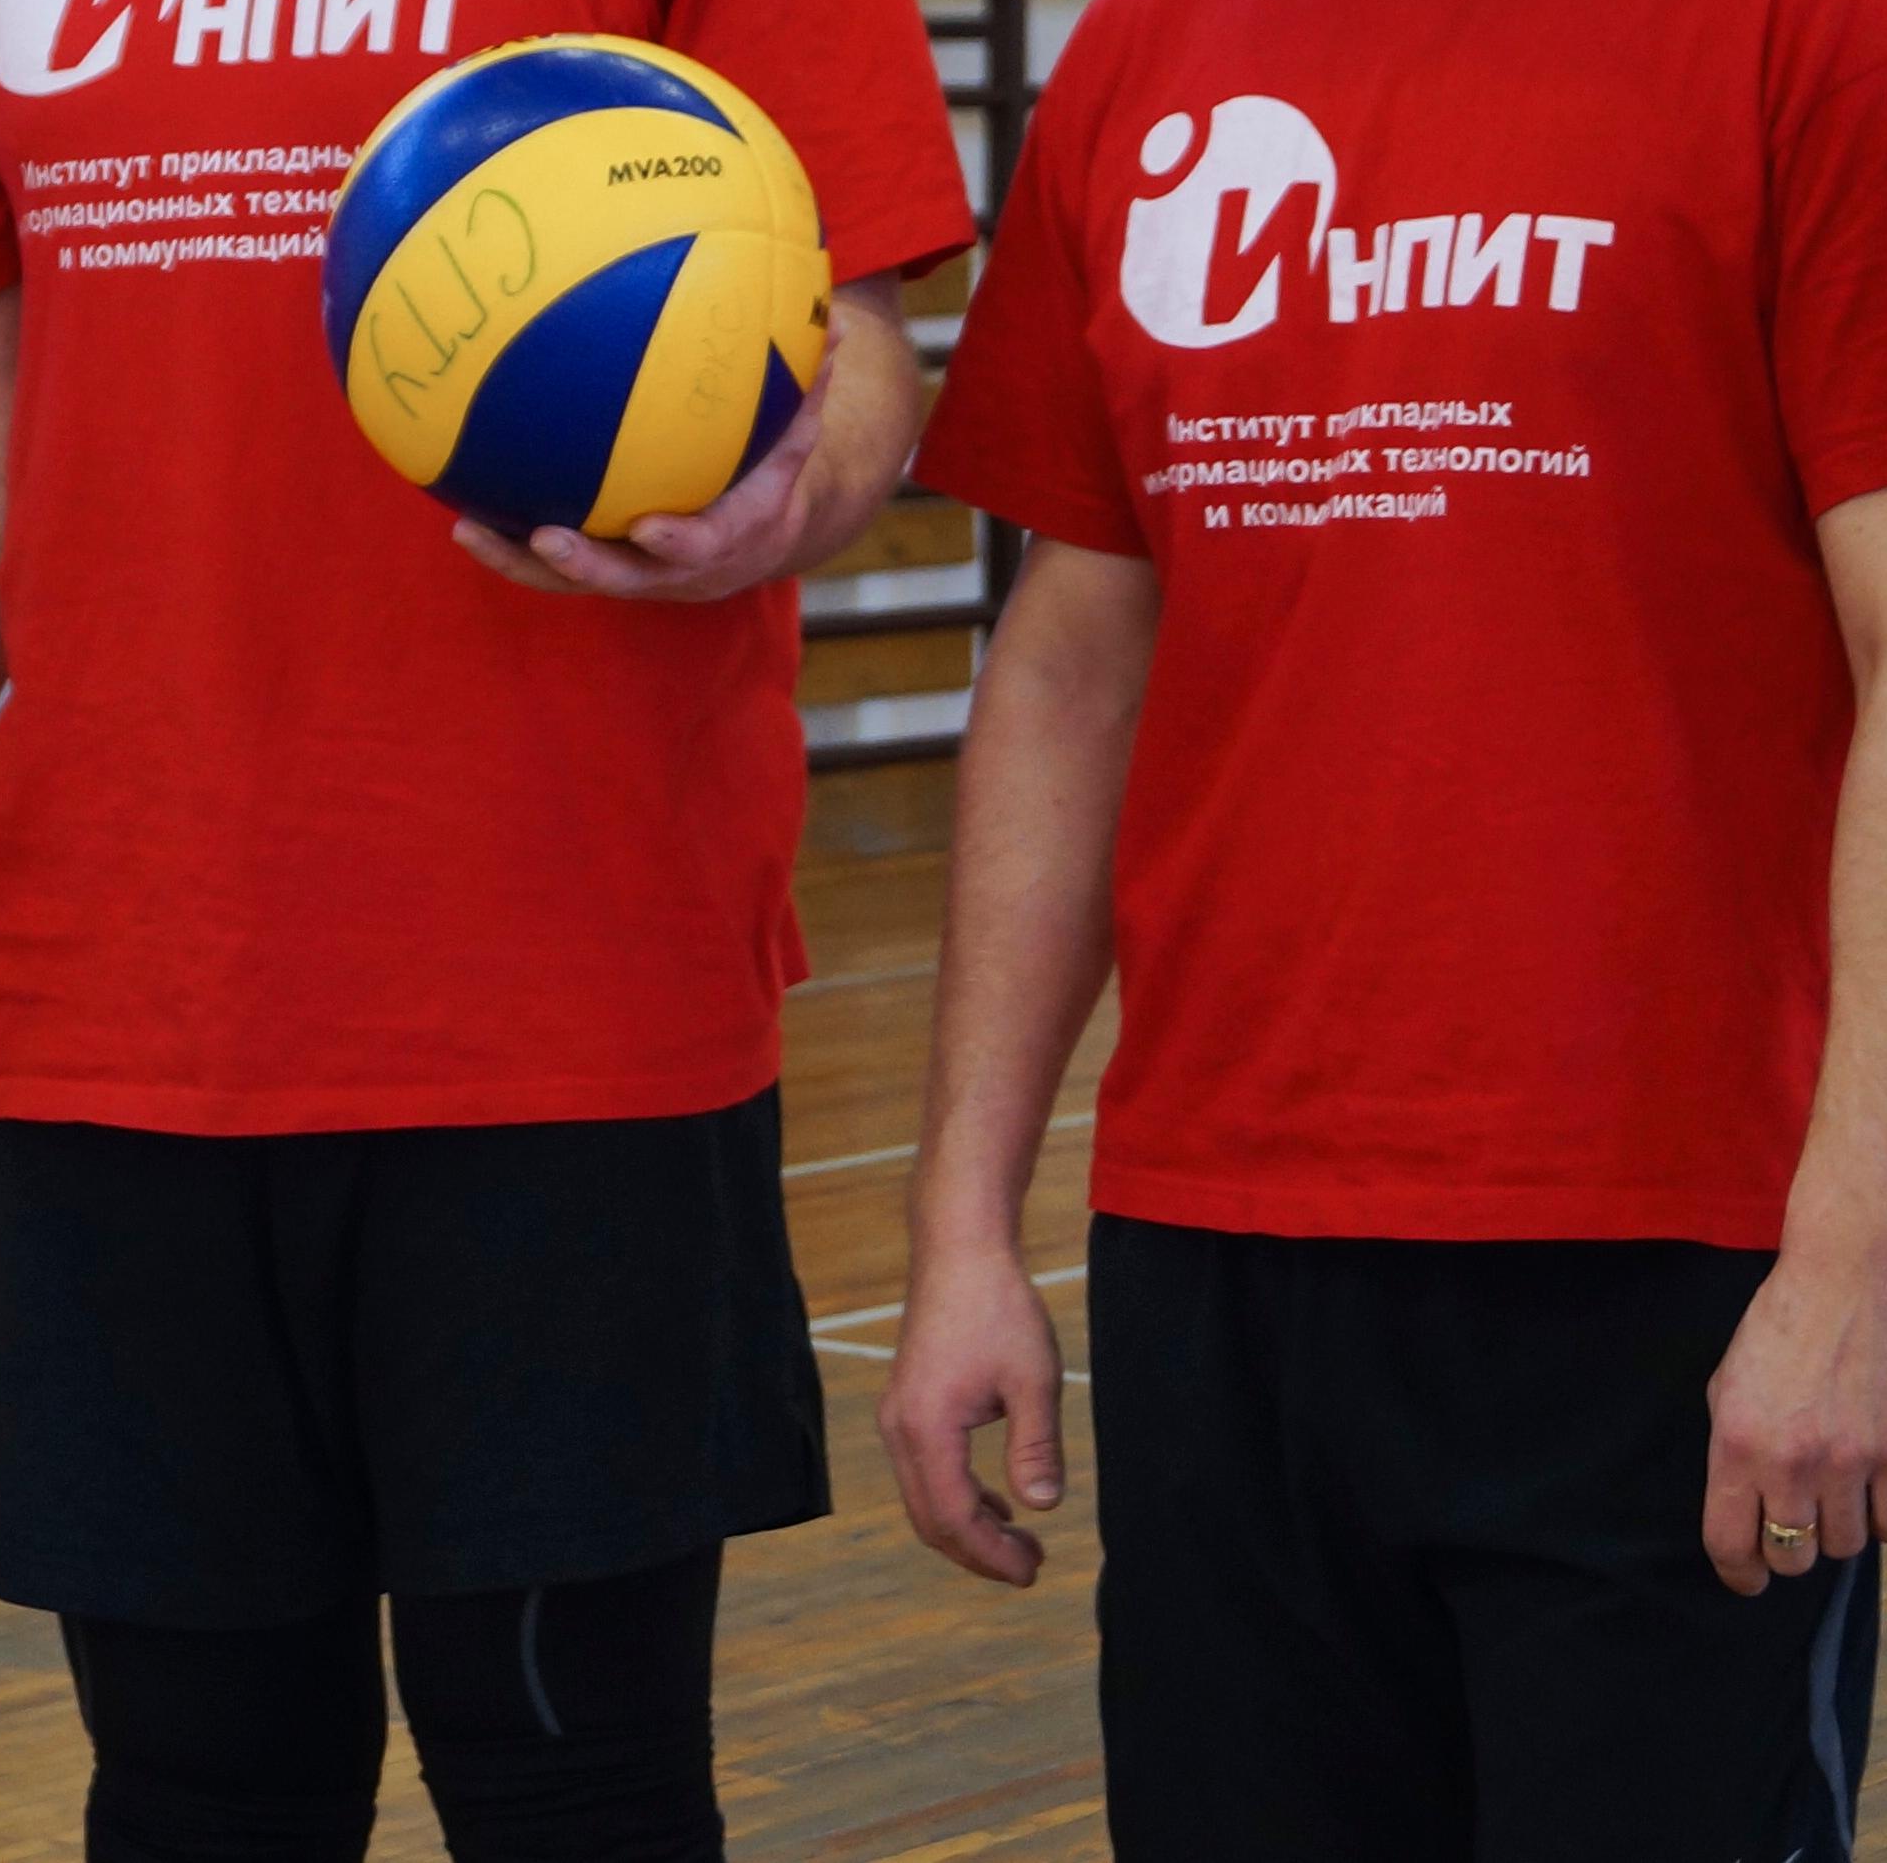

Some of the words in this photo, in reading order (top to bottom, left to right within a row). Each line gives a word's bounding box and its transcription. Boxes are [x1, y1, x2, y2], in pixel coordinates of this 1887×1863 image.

[21, 154, 152, 190] Институт
[160, 141, 363, 183] прикладны
[607, 154, 724, 187] MVA200
[20, 191, 235, 236] ормационных
[58, 246, 75, 270] и
[79, 224, 327, 271] коммуникаций
[1381, 443, 1591, 478] технологий
[1203, 504, 1231, 529] и
